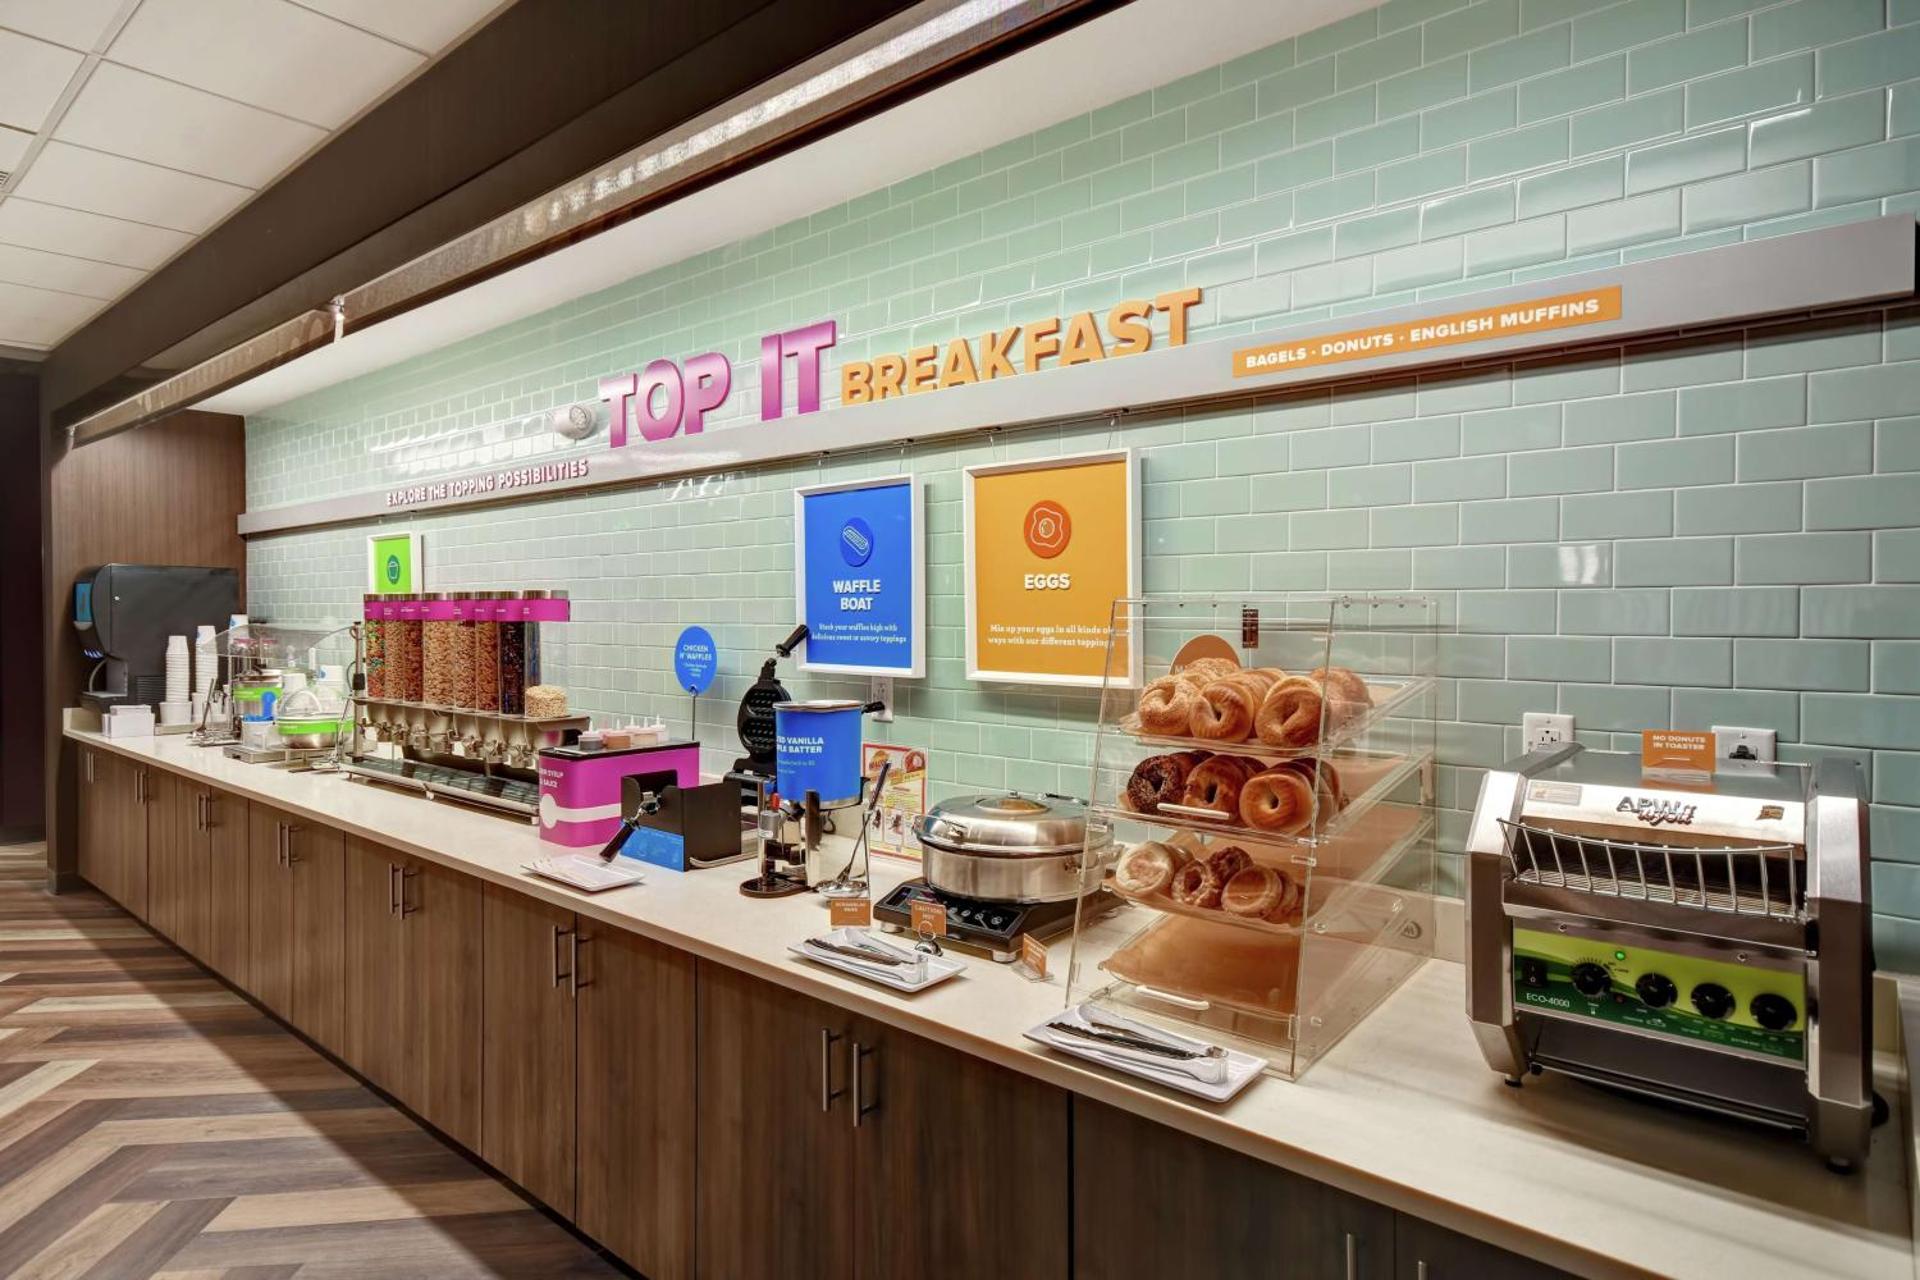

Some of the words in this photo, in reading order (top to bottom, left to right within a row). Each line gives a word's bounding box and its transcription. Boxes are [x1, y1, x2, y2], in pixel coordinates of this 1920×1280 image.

[1246, 347, 1307, 369] BAGELS
[1321, 332, 1393, 357] DONUTS
[1410, 316, 1493, 343] ENGLISH
[1500, 298, 1600, 328] MUFFINS
[599, 352, 731, 448] TOP
[761, 319, 836, 421] IT
[841, 288, 1202, 406] BREAKFAST
[386, 487, 427, 507] EXPLORE
[428, 483, 447, 501] THE
[450, 476, 495, 498] TOPPING
[498, 460, 589, 489] POSSIBILITIES
[832, 579, 881, 594] WAFFLE
[1024, 573, 1071, 590] EGGS
[840, 597, 874, 611] BOAT
[1006, 626, 1015, 635] up
[1016, 626, 1035, 635] your
[1036, 626, 1054, 636] eggs
[1055, 624, 1064, 633] in
[1065, 624, 1076, 633] all
[1007, 636, 1025, 645] with
[1041, 637, 1075, 646] different
[786, 736, 824, 745] VANILLA
[1665, 742, 1705, 751] TOASTER
[1668, 735, 1706, 744] DONUTS
[788, 745, 823, 754] BATTER
[1526, 992, 1571, 1009] ECO-4000
